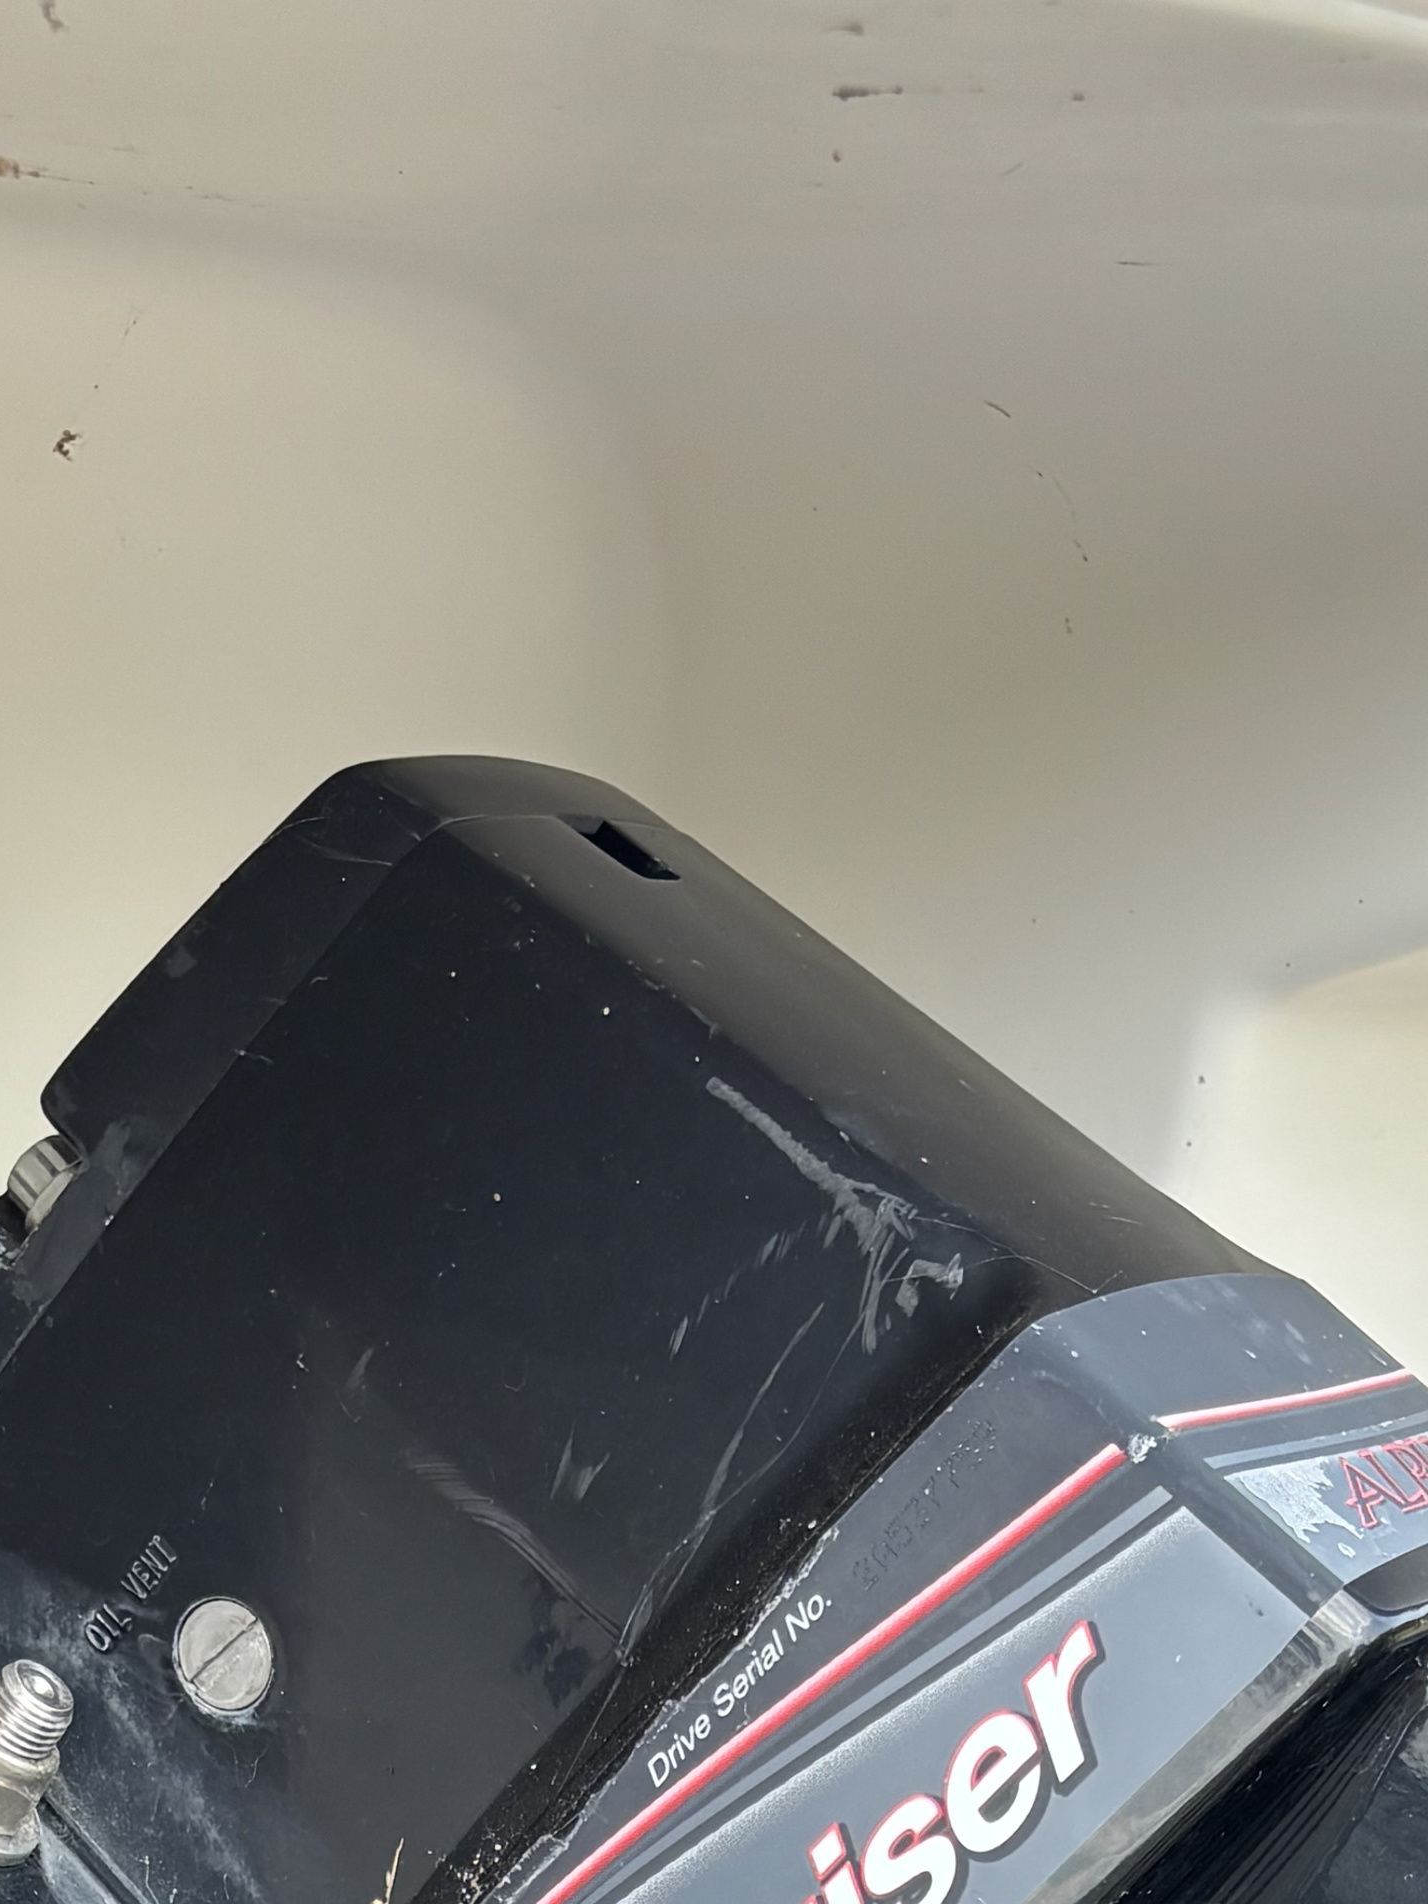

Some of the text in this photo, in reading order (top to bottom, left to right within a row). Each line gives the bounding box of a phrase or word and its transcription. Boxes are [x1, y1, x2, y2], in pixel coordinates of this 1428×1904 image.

[85, 1534, 178, 1652] OIL VENT
[647, 1594, 833, 1788] Drive Serial No.
